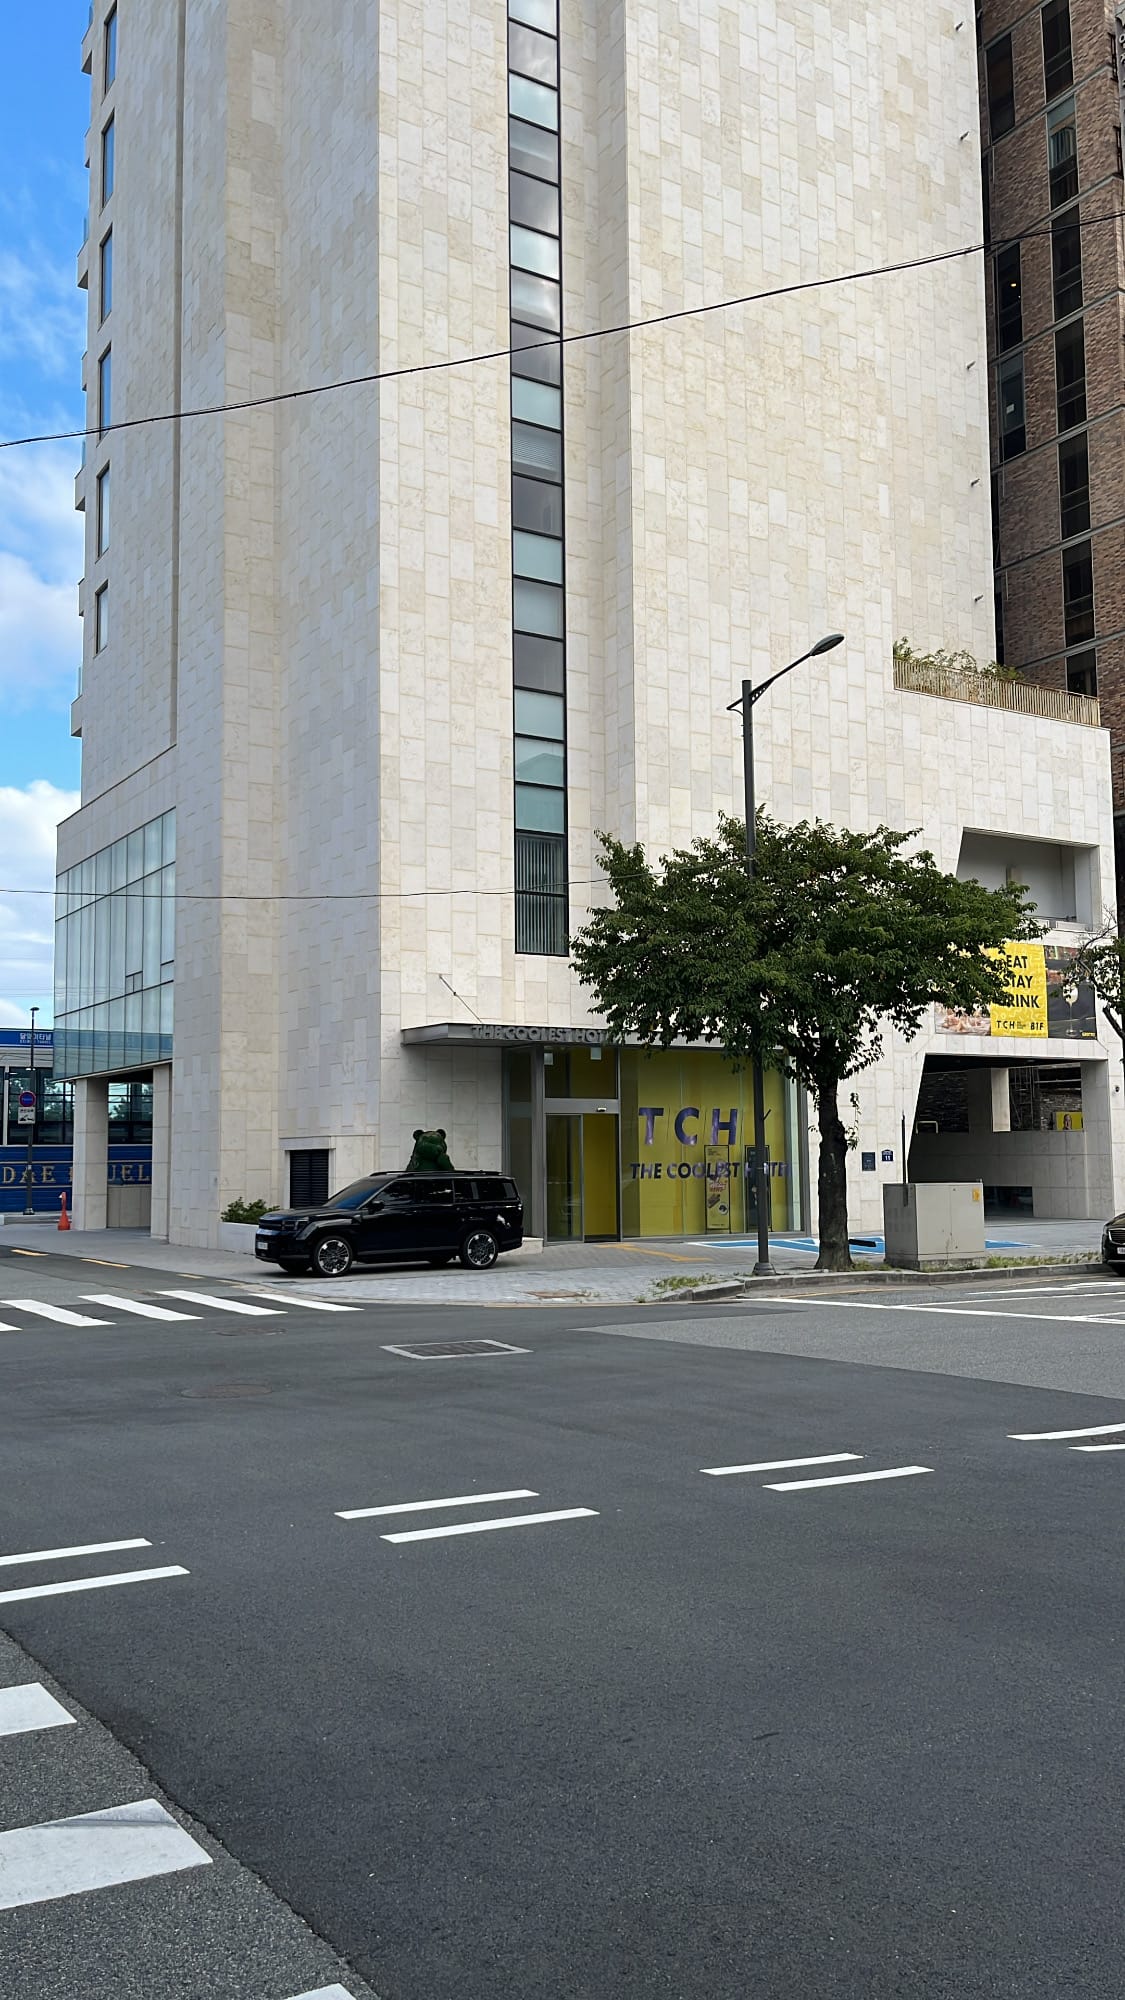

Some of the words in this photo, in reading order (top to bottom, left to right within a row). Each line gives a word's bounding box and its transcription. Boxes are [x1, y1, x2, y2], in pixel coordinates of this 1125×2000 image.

[1006, 954, 1028, 968] EAT
[1003, 973, 1033, 988] STAY
[1003, 993, 1040, 1008] RINK
[471, 1025, 501, 1039] THE
[505, 1026, 573, 1042] COOLEST
[575, 1029, 608, 1043] HOT
[630, 1162, 662, 1179] THE
[666, 1162, 740, 1180] COOLEST
[744, 1162, 792, 1179] HTEL
